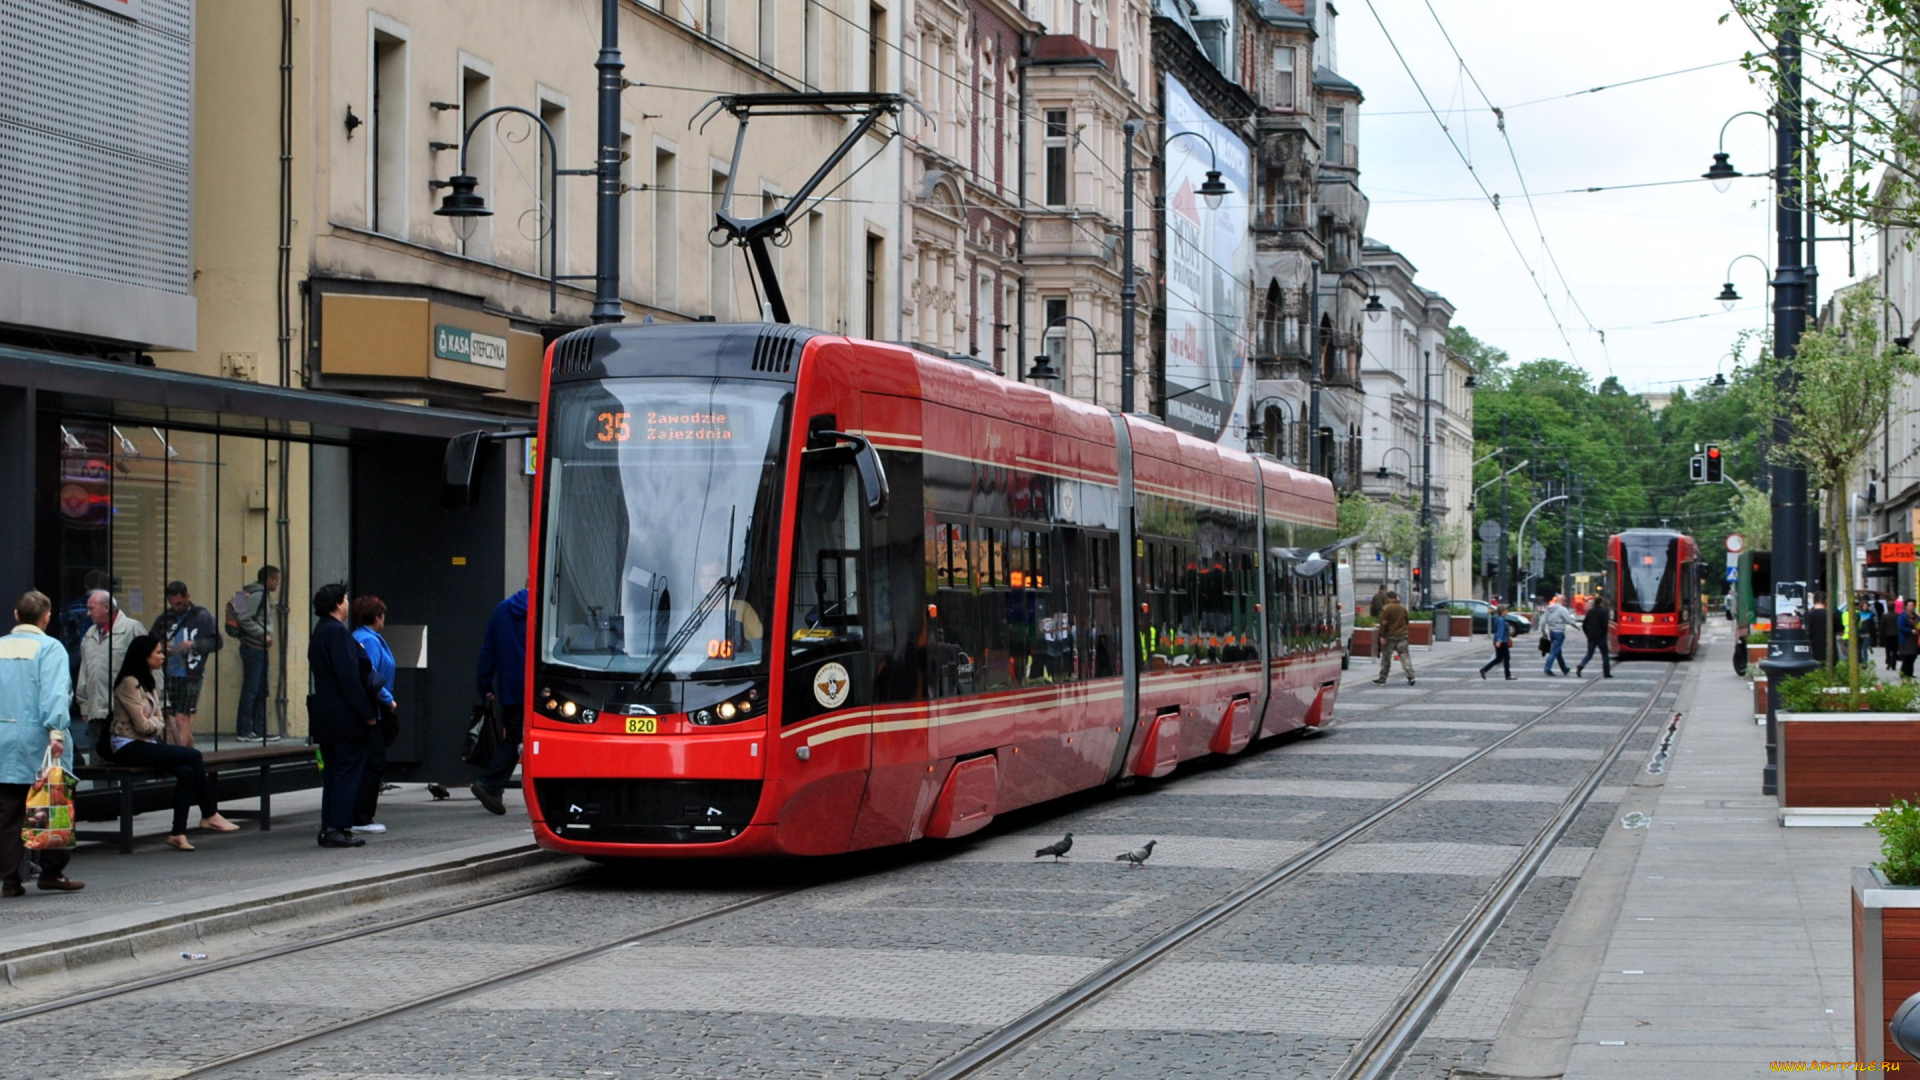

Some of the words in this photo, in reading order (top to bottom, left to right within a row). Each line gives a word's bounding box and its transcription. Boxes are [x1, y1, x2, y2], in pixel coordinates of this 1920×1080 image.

[448, 334, 470, 355] KASA
[472, 339, 505, 361] STEFCZYKA
[646, 411, 727, 424] Zawodzie
[598, 412, 631, 441] 35
[646, 428, 732, 441] Zajezdnia
[707, 639, 733, 658] 06
[628, 719, 655, 733] 820
